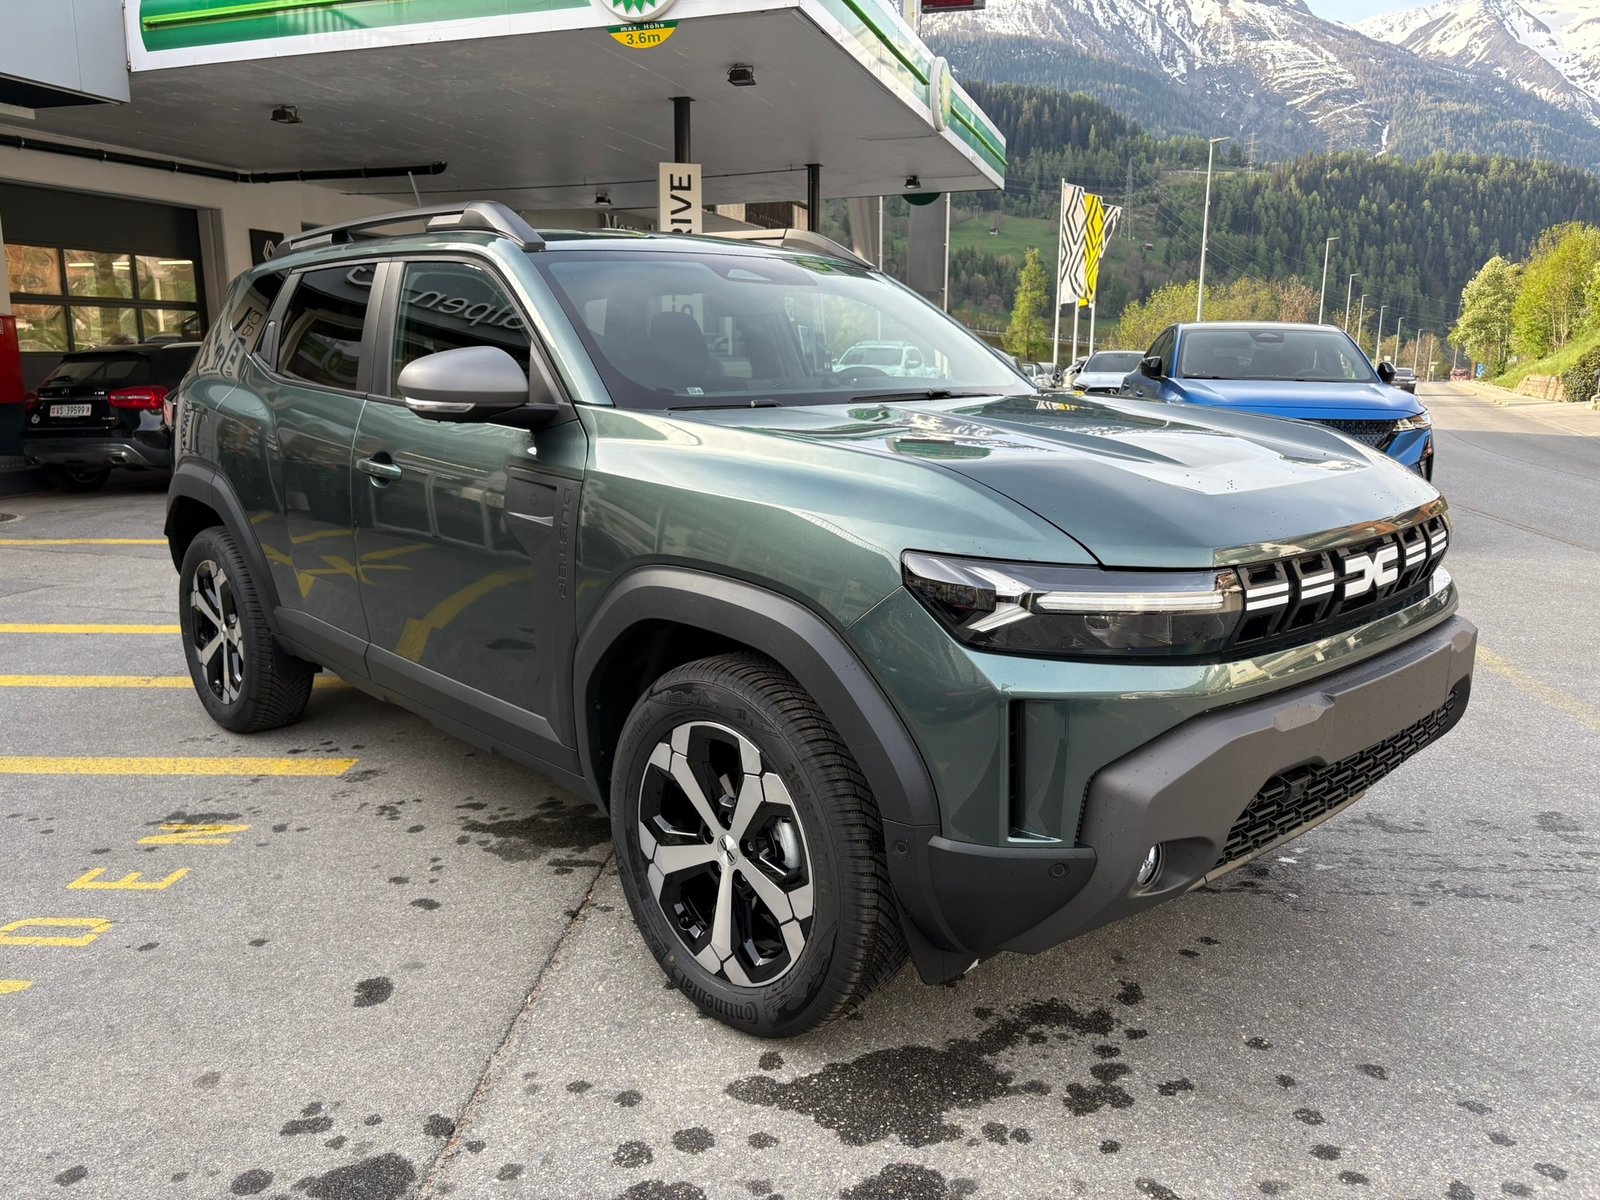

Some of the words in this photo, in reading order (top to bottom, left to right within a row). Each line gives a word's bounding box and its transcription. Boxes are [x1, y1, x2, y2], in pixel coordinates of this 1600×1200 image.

[626, 32, 661, 45] 3.6m
[643, 22, 665, 30] Höhe
[558, 487, 573, 599] DUSTER
[0, 822, 253, 995] DEN
[679, 974, 760, 1026] Continental
